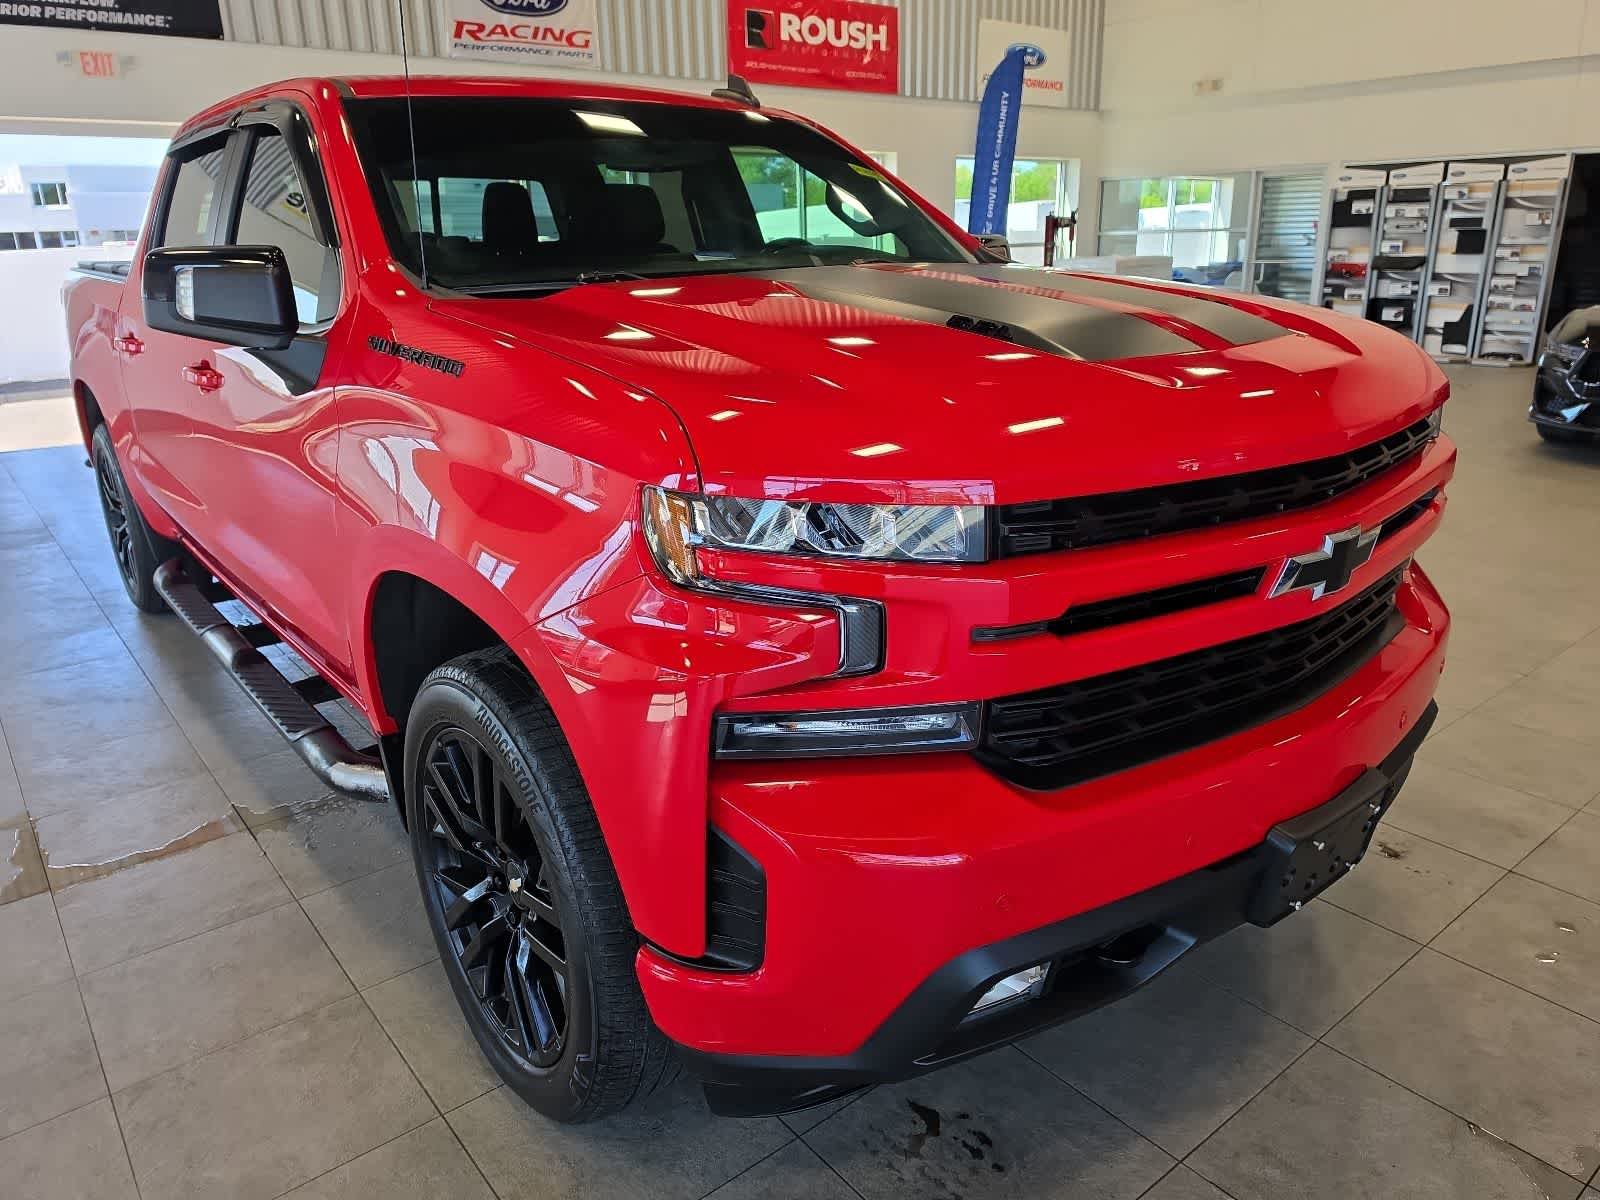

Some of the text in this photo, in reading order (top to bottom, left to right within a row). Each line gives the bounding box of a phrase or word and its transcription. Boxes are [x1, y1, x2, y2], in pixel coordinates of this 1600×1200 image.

[453, 20, 593, 48] RACING
[780, 12, 888, 51] ROUSH
[80, 52, 114, 76] EXIT
[454, 42, 593, 58] PERFORMANCE PARTS
[367, 335, 465, 378] SILVERADO
